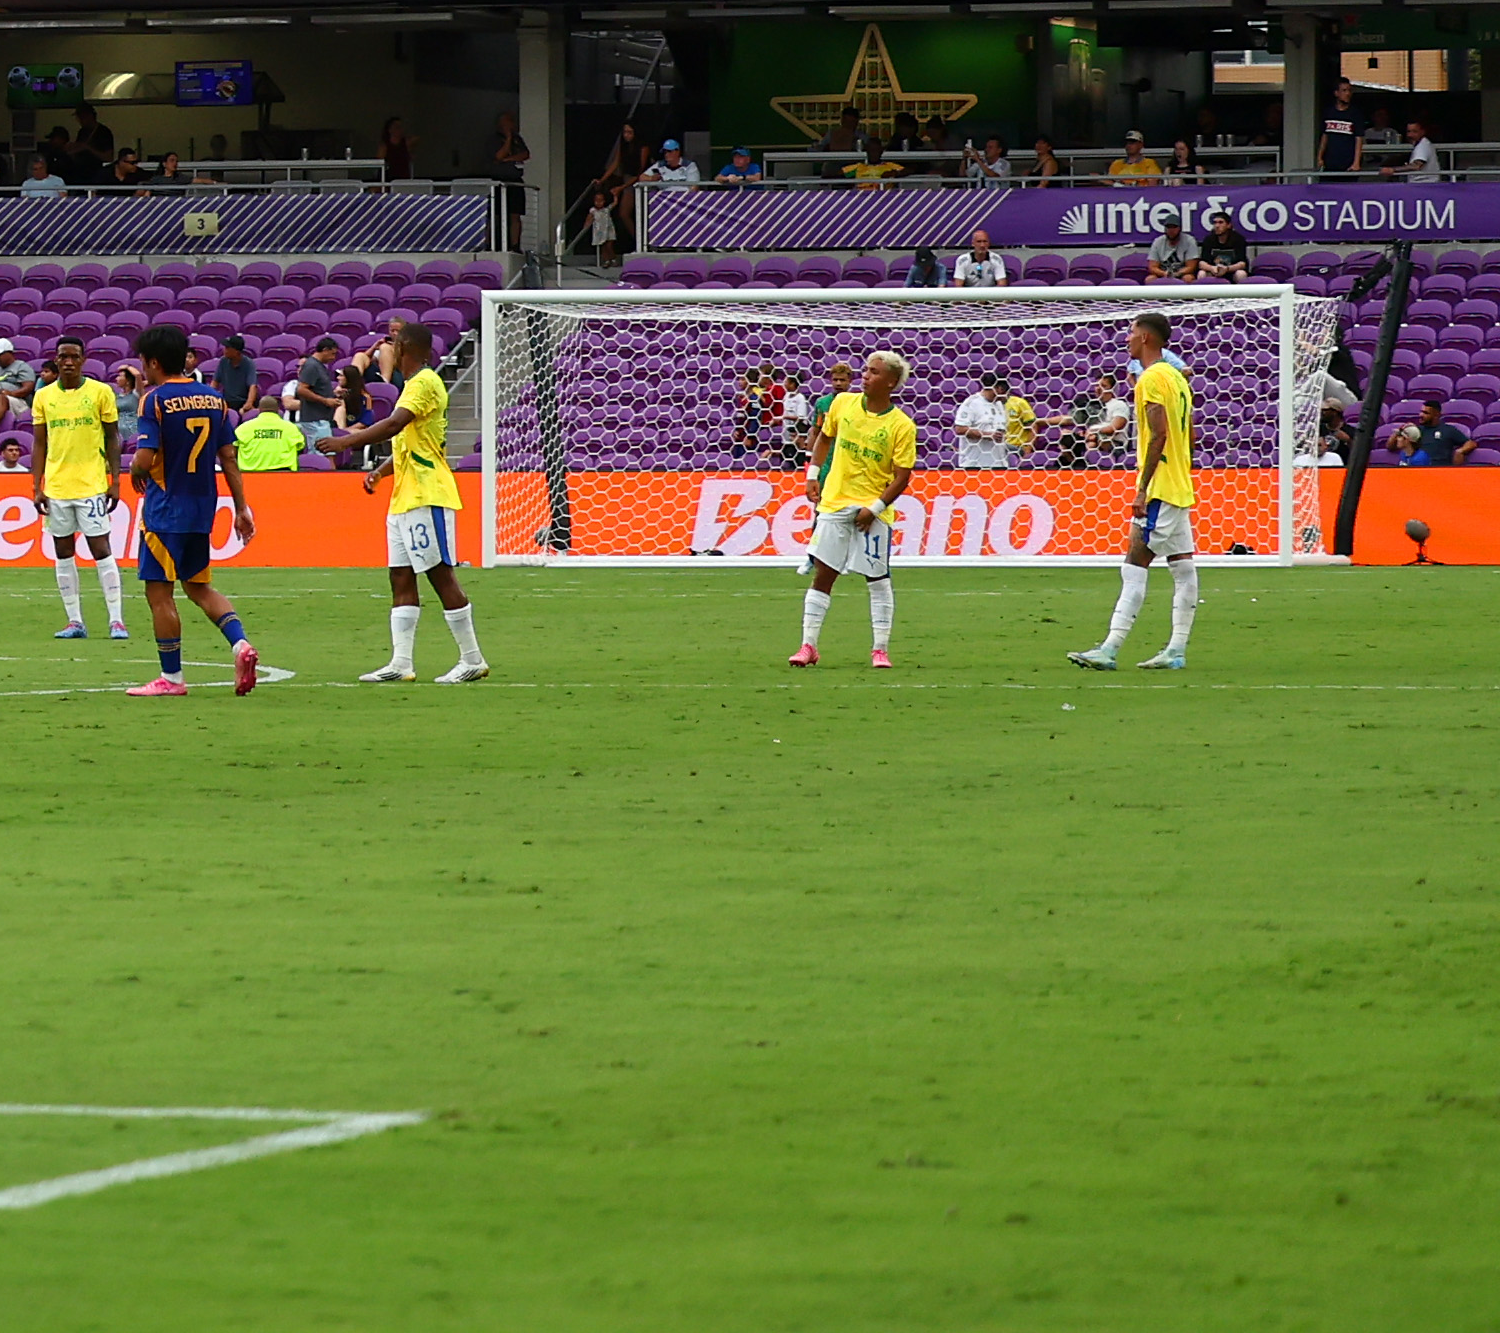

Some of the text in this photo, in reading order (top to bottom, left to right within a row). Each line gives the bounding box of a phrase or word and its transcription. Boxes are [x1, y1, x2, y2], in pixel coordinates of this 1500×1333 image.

[197, 218, 205, 231] 3
[1292, 199, 1455, 231] STADIUM
[164, 394, 223, 414] SEUNGBEOM
[185, 417, 210, 474] 7
[254, 429, 283, 440] SECURITY
[86, 494, 106, 518] 20
[690, 479, 1055, 555] Beano
[409, 523, 430, 551] 13
[864, 533, 881, 559] 11
